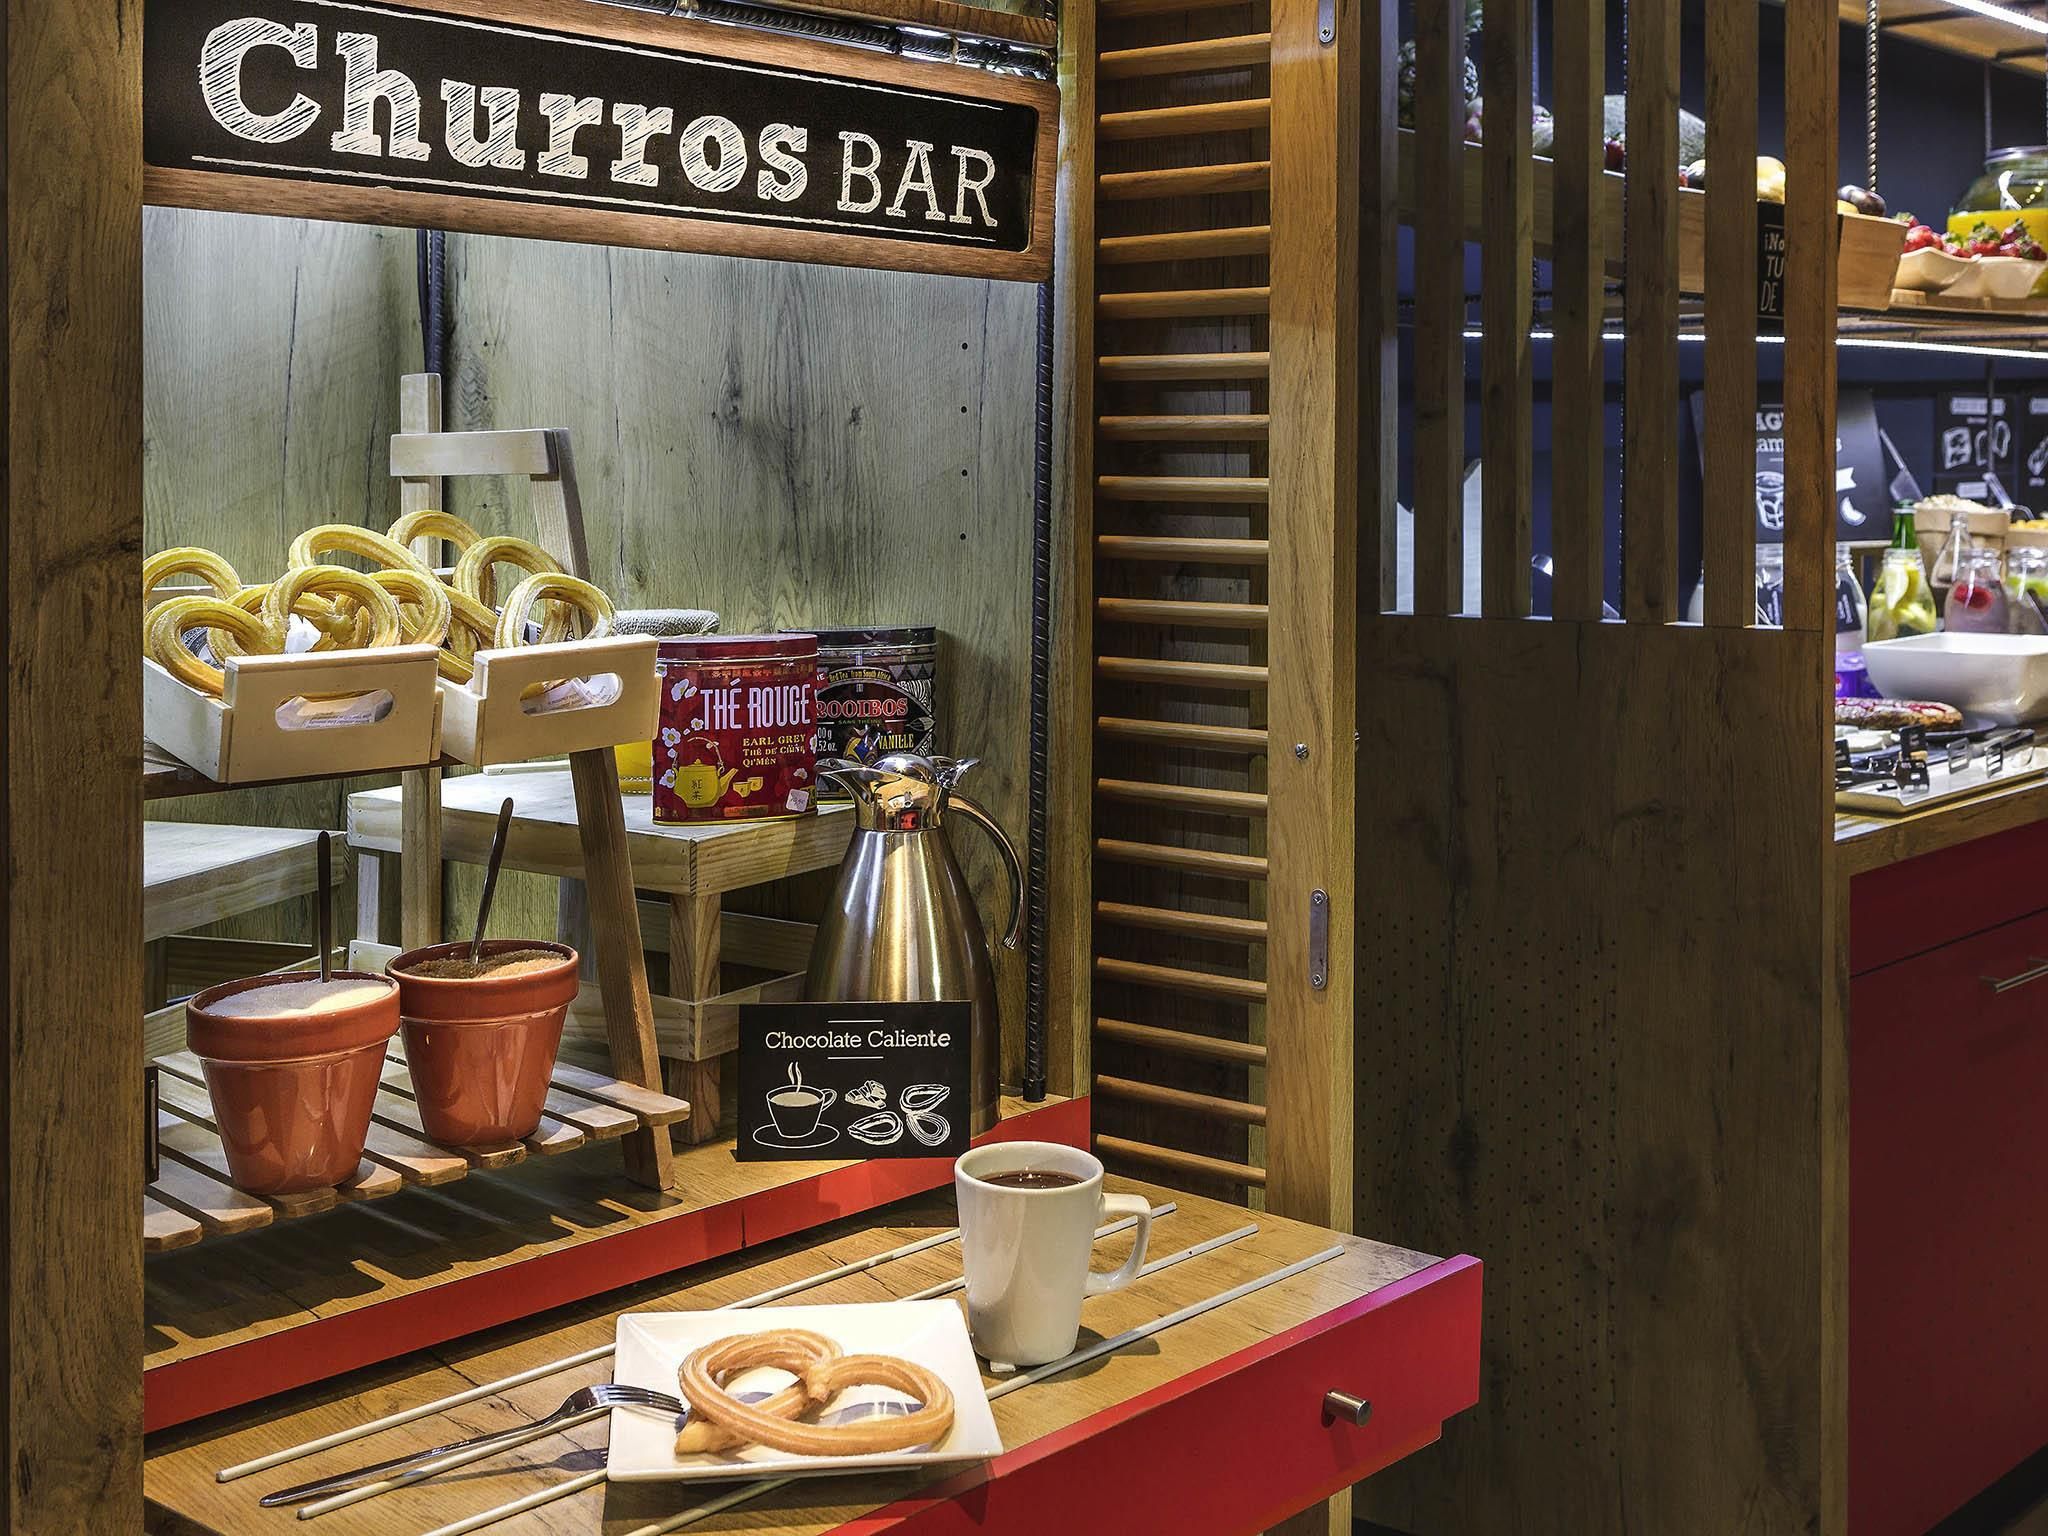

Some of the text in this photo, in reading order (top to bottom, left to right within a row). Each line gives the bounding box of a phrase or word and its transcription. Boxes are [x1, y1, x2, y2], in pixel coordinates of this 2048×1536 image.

[198, 17, 998, 227] Churros BAR
[700, 677, 811, 731] THÉ ROUGE
[816, 698, 908, 719] ROOIBOS
[743, 733, 806, 747] EARL GREY
[879, 733, 914, 750] VANILLE
[765, 1029, 951, 1049] Chocolate Caliente
